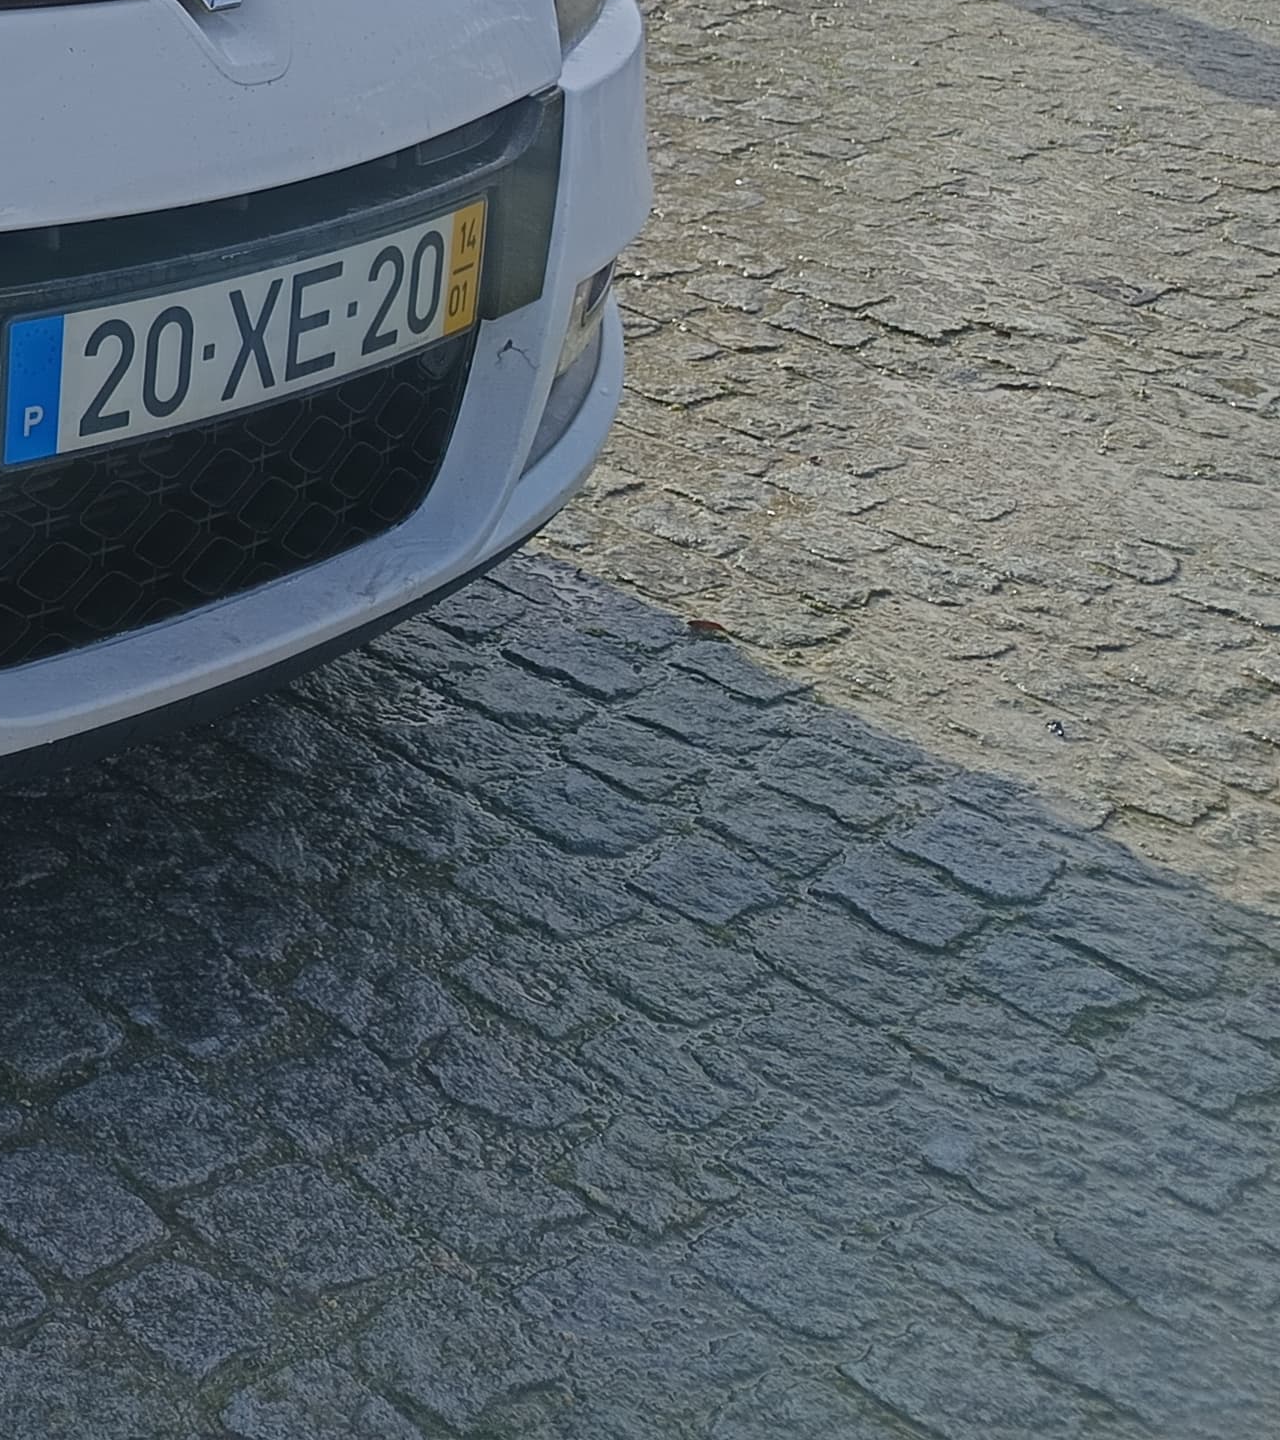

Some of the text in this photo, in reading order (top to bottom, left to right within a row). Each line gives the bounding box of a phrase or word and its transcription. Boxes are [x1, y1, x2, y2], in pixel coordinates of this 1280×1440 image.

[460, 217, 477, 254] 14
[448, 280, 468, 317] 01
[23, 405, 44, 437] P
